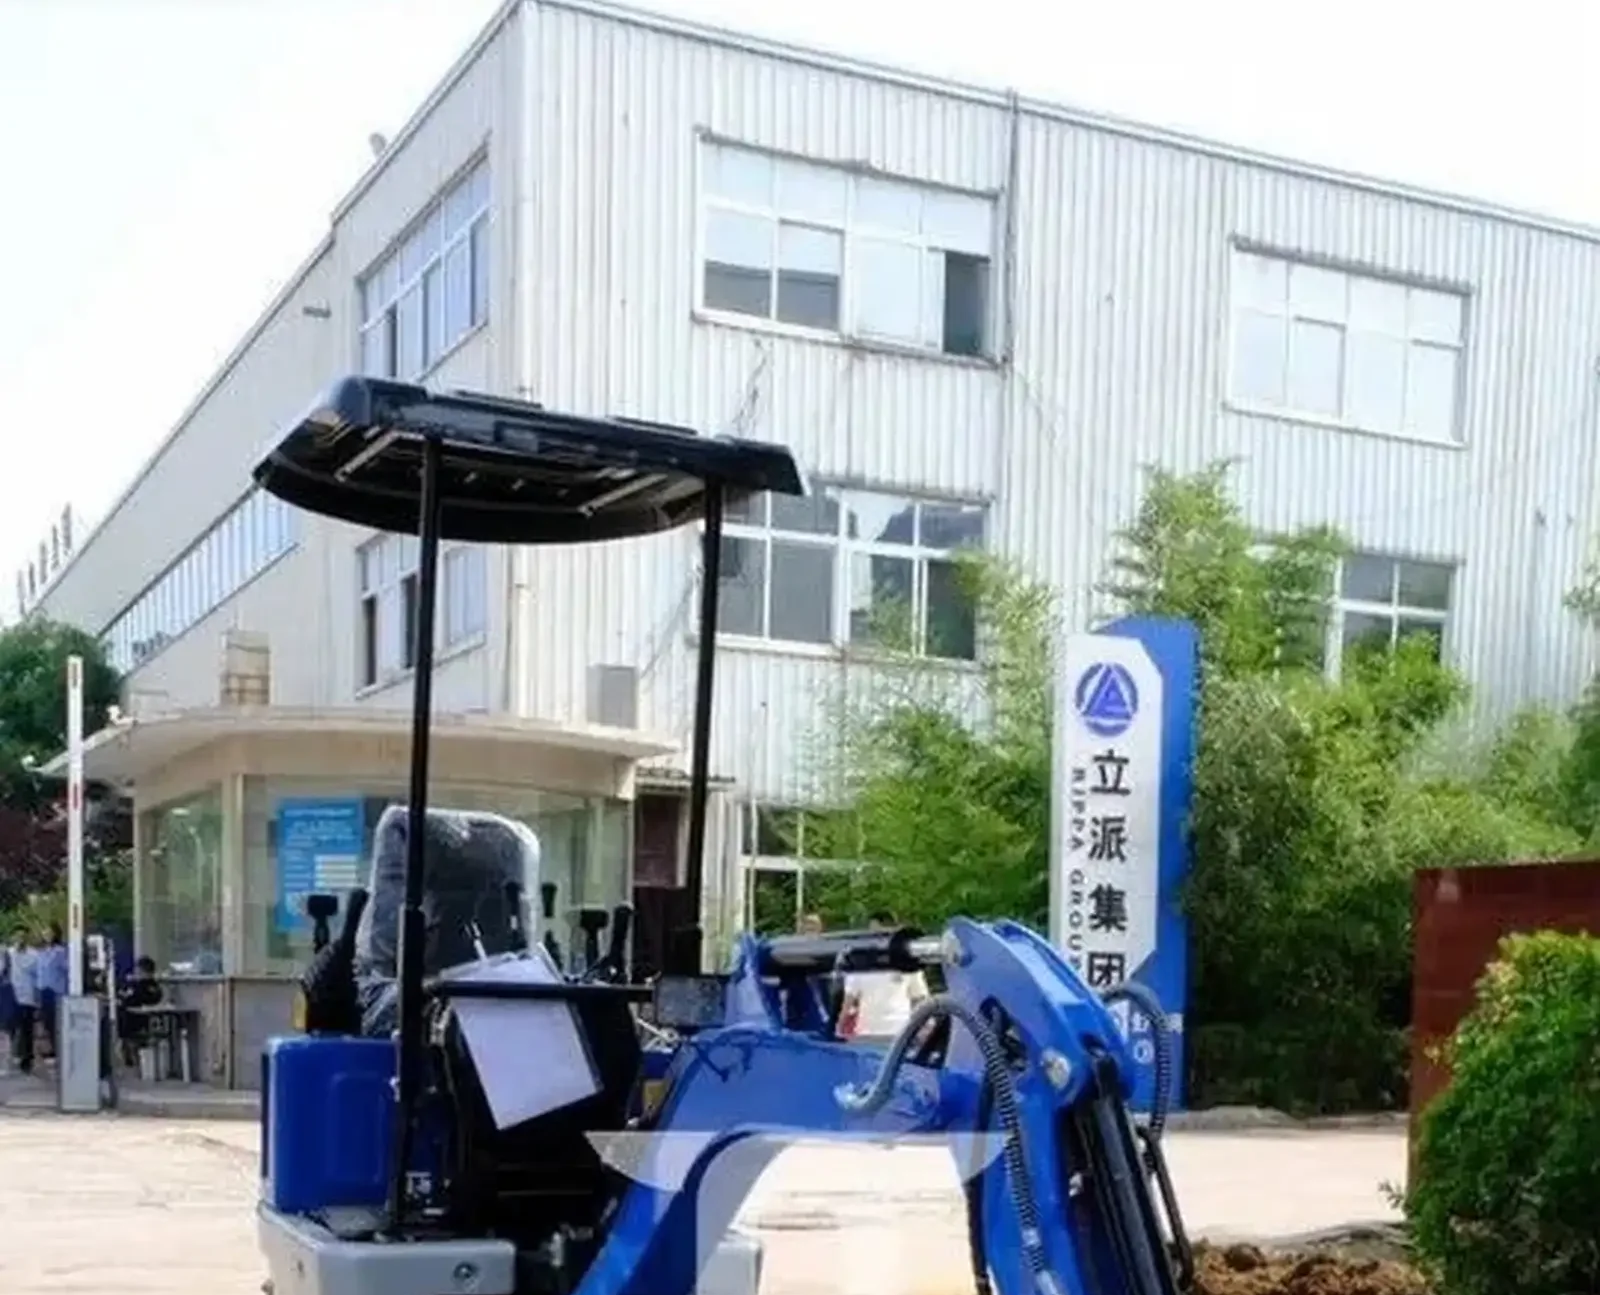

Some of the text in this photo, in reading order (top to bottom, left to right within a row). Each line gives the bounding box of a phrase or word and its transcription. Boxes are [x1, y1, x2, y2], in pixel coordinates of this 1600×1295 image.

[1071, 767, 1085, 850] RIPPA
[1088, 749, 1131, 987] 立派集团
